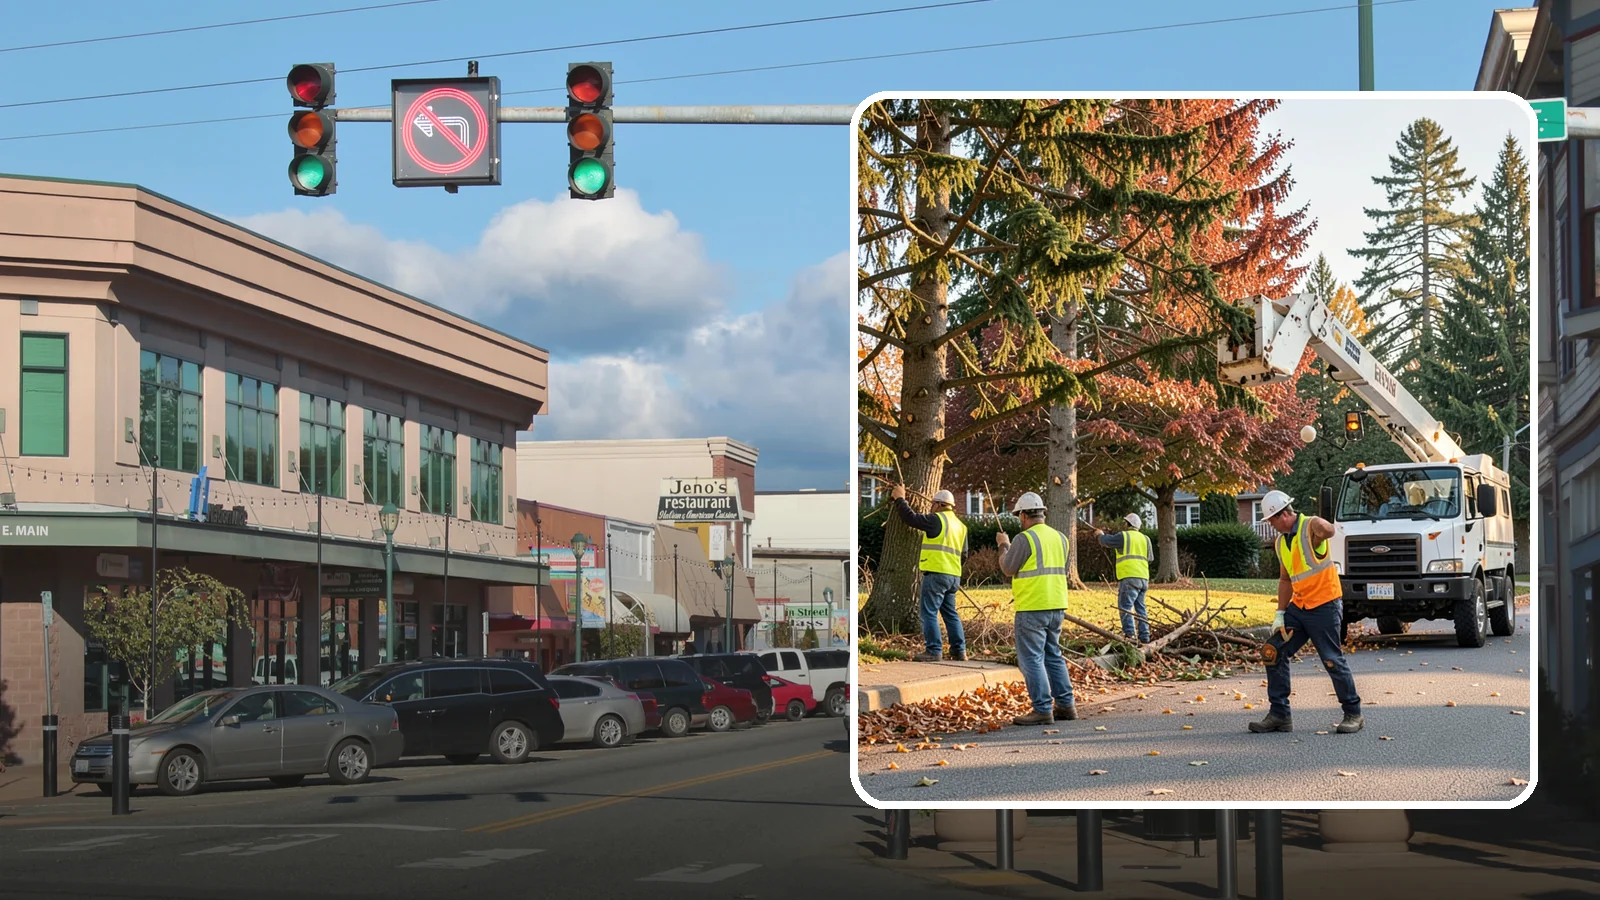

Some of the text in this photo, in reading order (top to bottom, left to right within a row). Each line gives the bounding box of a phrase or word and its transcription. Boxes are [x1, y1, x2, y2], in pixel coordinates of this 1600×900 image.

[669, 480, 728, 494] Jeno's
[665, 496, 731, 509] restaurant
[685, 509, 714, 519] American
[714, 509, 738, 519] Cuisine
[2, 525, 49, 536] E. MAIN
[797, 607, 829, 617] Street
[790, 619, 824, 627] lass
